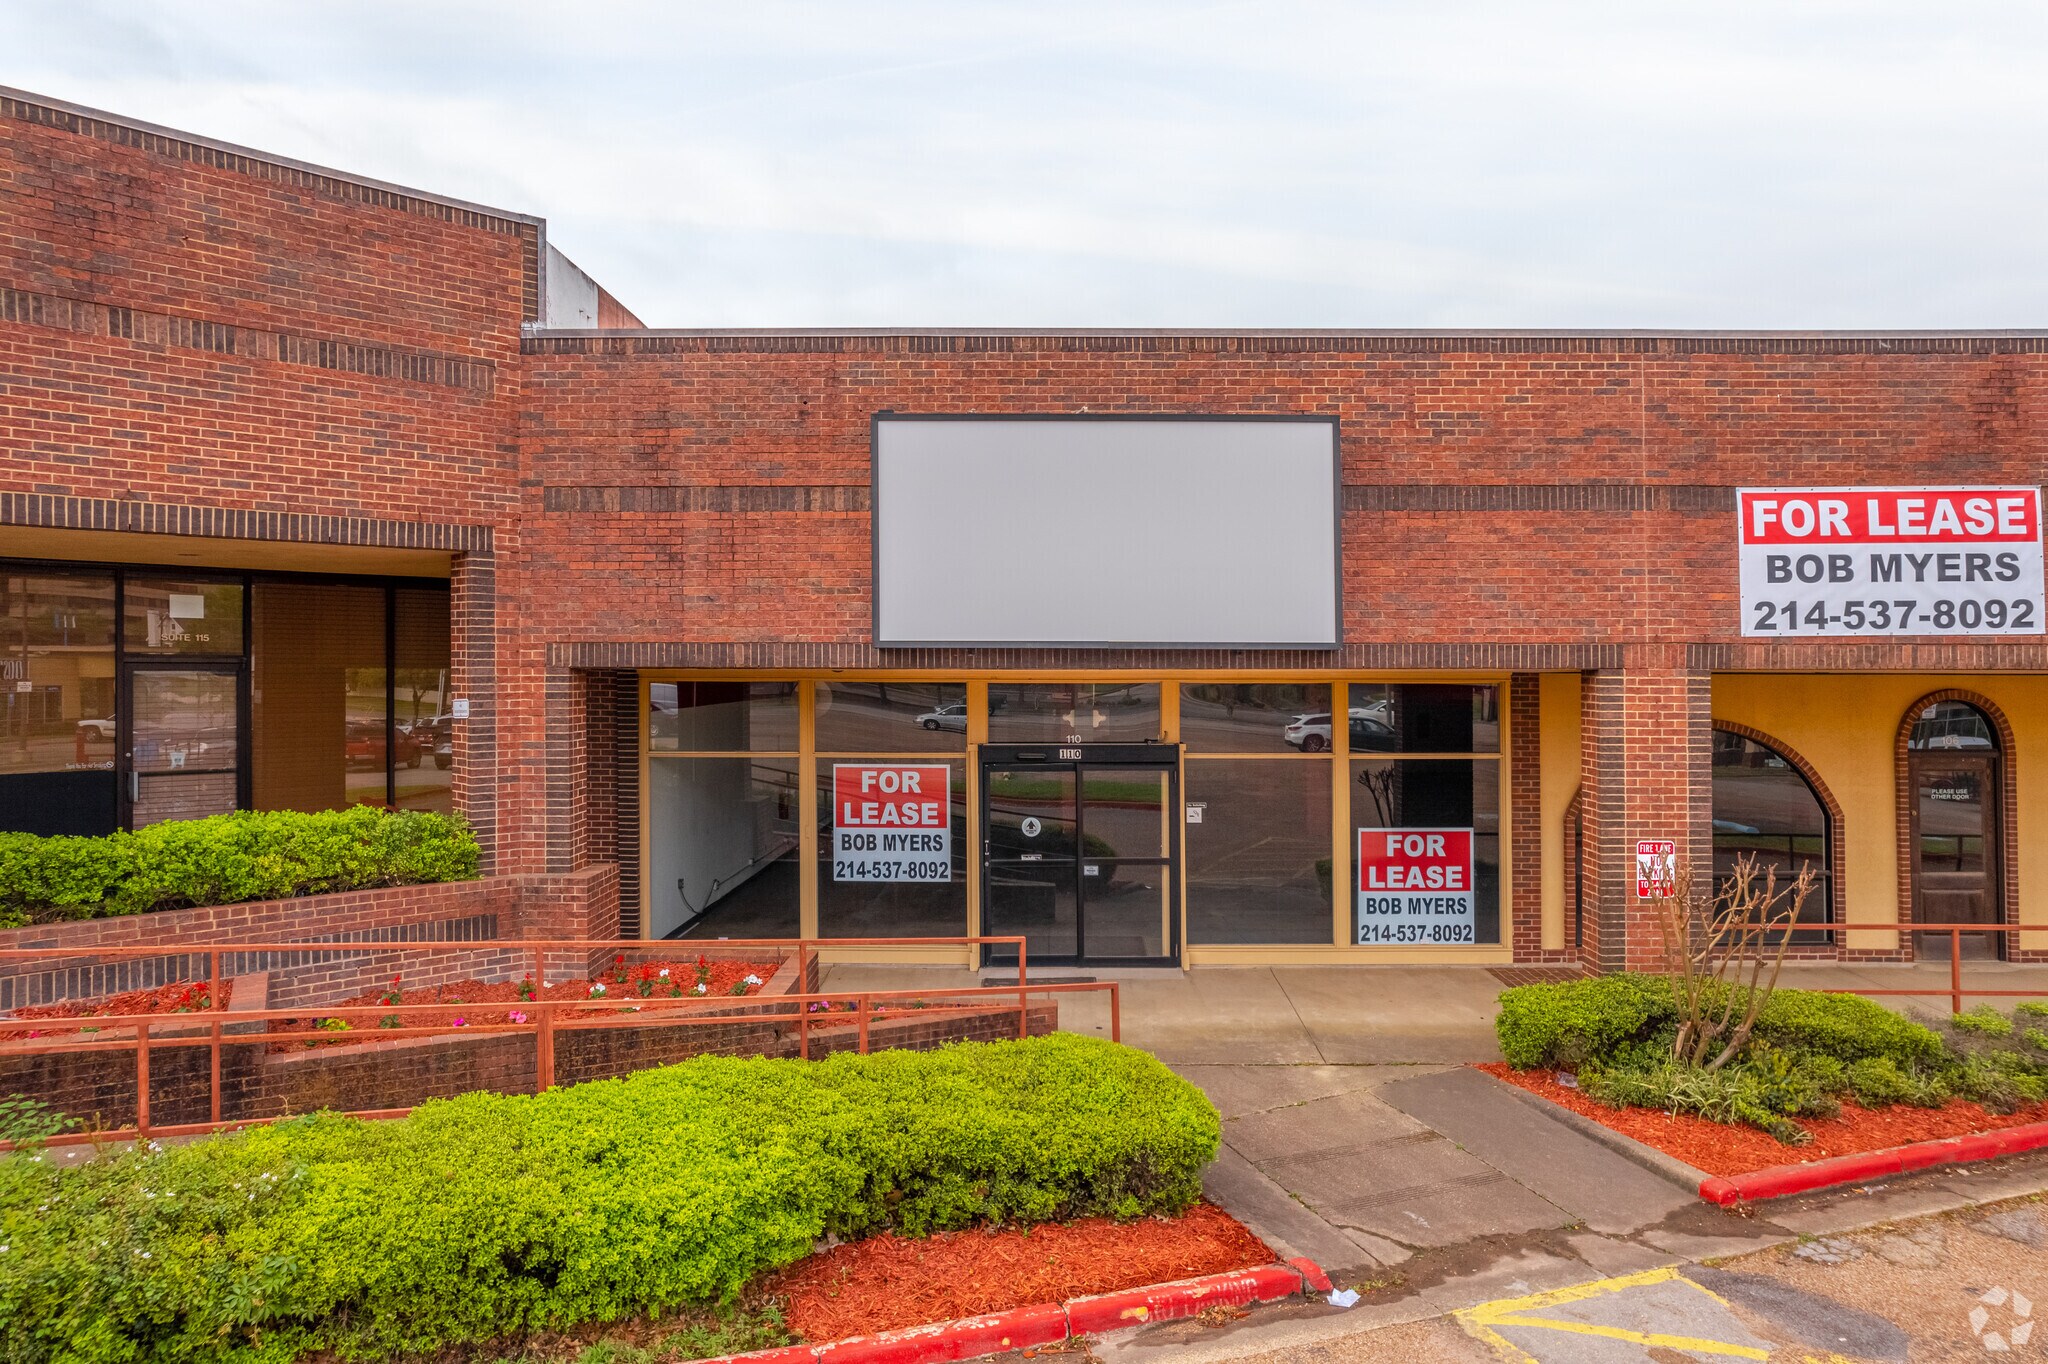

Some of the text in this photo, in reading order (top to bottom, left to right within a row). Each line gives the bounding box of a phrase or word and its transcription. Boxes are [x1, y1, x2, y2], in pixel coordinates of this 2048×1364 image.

[1752, 498, 2027, 537] FOR LEASE
[1766, 552, 2021, 583] BOB MYERS
[1754, 599, 2034, 630] 214-537-8092
[161, 633, 210, 642] SUITE 115
[1066, 734, 1081, 743] 110
[1942, 736, 1960, 745] 106
[1060, 749, 1081, 759] 110
[861, 770, 921, 793] FOR
[843, 802, 938, 825] LEASE
[841, 834, 943, 852] BOB MYERS
[1386, 834, 1446, 857] FOR
[1639, 844, 1653, 853] FIRE
[836, 861, 949, 879] 214-537-8092
[1369, 866, 1463, 888] LEASE
[1366, 897, 1467, 915] BOB MYERS
[1361, 924, 1472, 942] 214-537-8092
